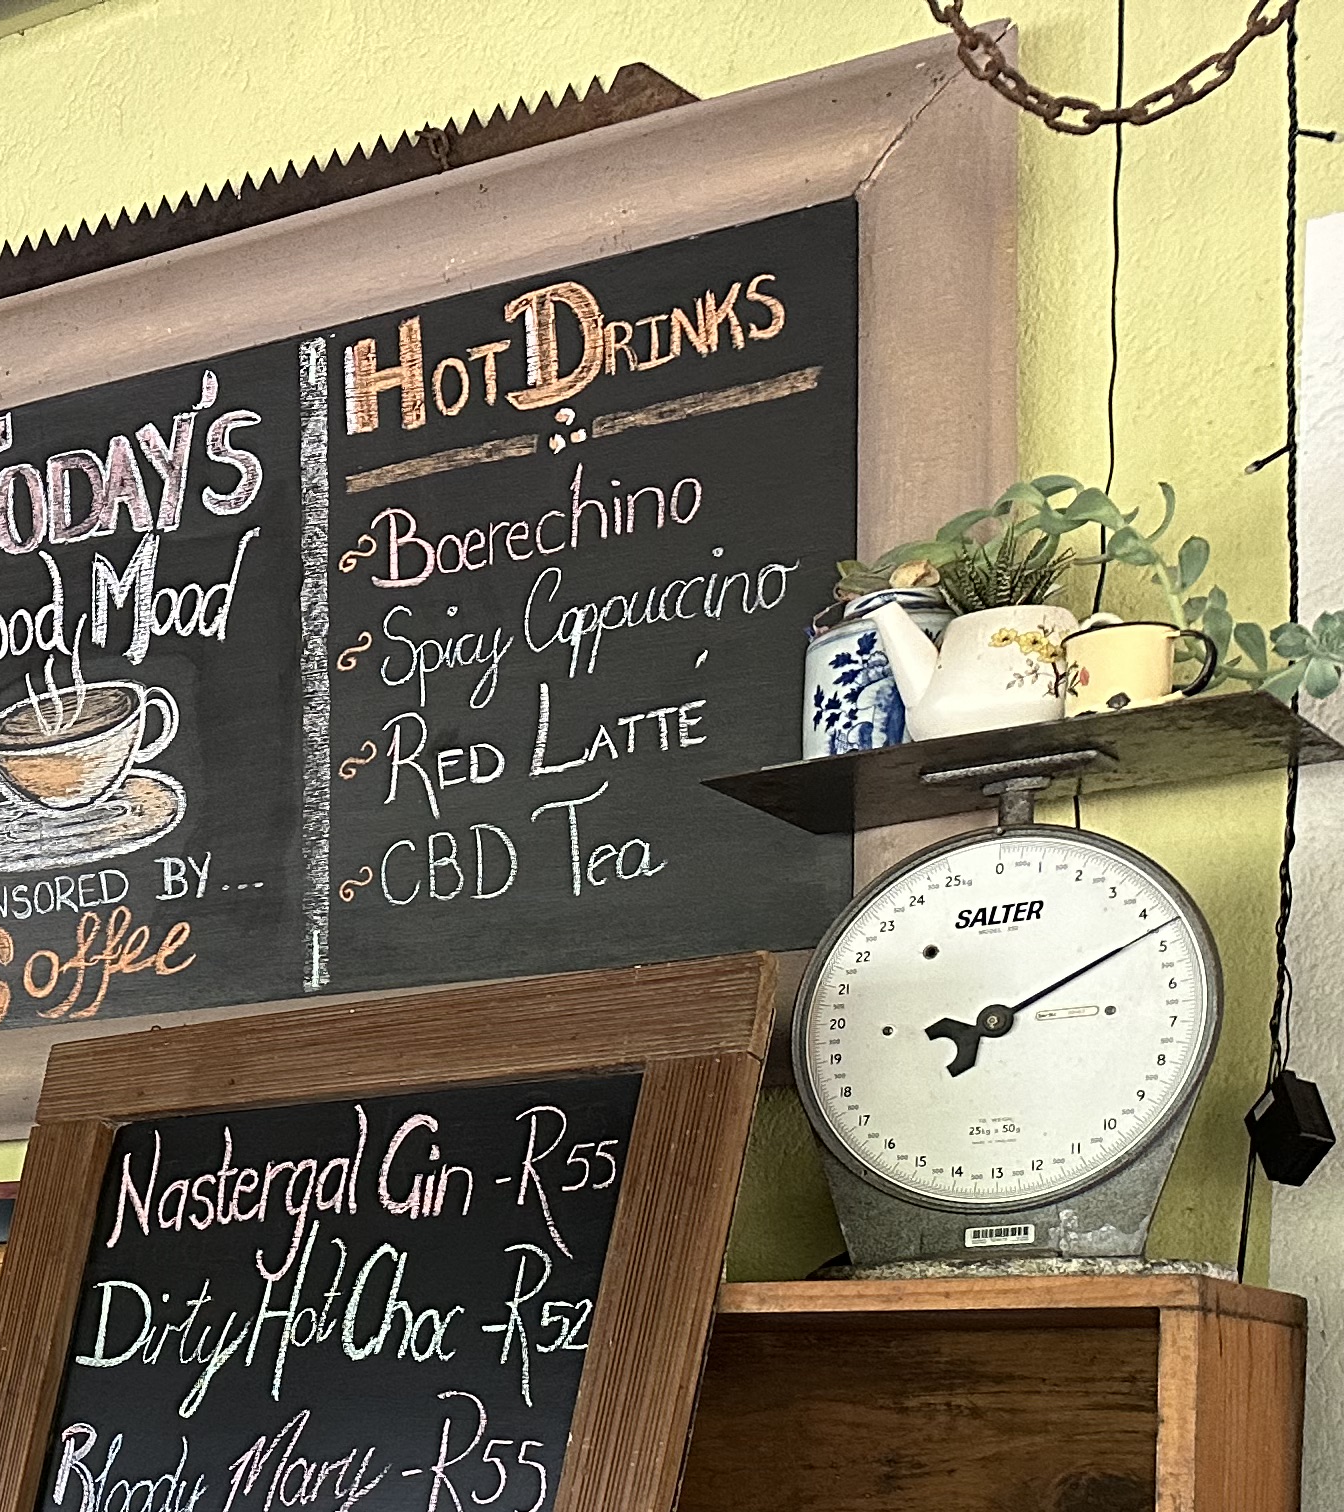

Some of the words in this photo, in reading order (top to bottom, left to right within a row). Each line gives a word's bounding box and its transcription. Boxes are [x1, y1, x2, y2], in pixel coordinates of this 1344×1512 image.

[370, 463, 703, 588] Boerechino
[91, 527, 261, 665] Mood
[381, 605, 514, 709] Spicy
[524, 548, 800, 678] Cappuccino
[381, 823, 518, 905] CBD
[531, 781, 668, 897] Tea
[995, 863, 1005, 875] 0
[1074, 869, 1084, 882] 2
[1108, 886, 1118, 899] 3
[909, 895, 926, 907] 24
[954, 900, 1045, 930] SALTER
[1138, 908, 1148, 920] 4
[879, 920, 896, 933] 23
[1158, 940, 1168, 953] 5
[855, 951, 871, 963] 22
[1168, 977, 1178, 989] 6
[837, 983, 850, 996] 21
[829, 1018, 846, 1030] 20
[1169, 1015, 1178, 1027] 7
[829, 1053, 842, 1065] 19
[1156, 1054, 1166, 1066] 8
[840, 1086, 852, 1098] 18
[1136, 1089, 1146, 1101] 9
[858, 1115, 871, 1127] 17
[1103, 1118, 1117, 1130] 10
[884, 1138, 896, 1150] 16
[1071, 1142, 1081, 1154] 11
[915, 1156, 927, 1167] 15
[1031, 1159, 1044, 1171] 12
[951, 1166, 964, 1178] 14
[991, 1167, 1004, 1179] 13
[107, 1105, 367, 1281] Nastergal
[379, 1113, 474, 1219] Gin
[76, 1278, 254, 1418] Dirty
[244, 1220, 347, 1402] Hot
